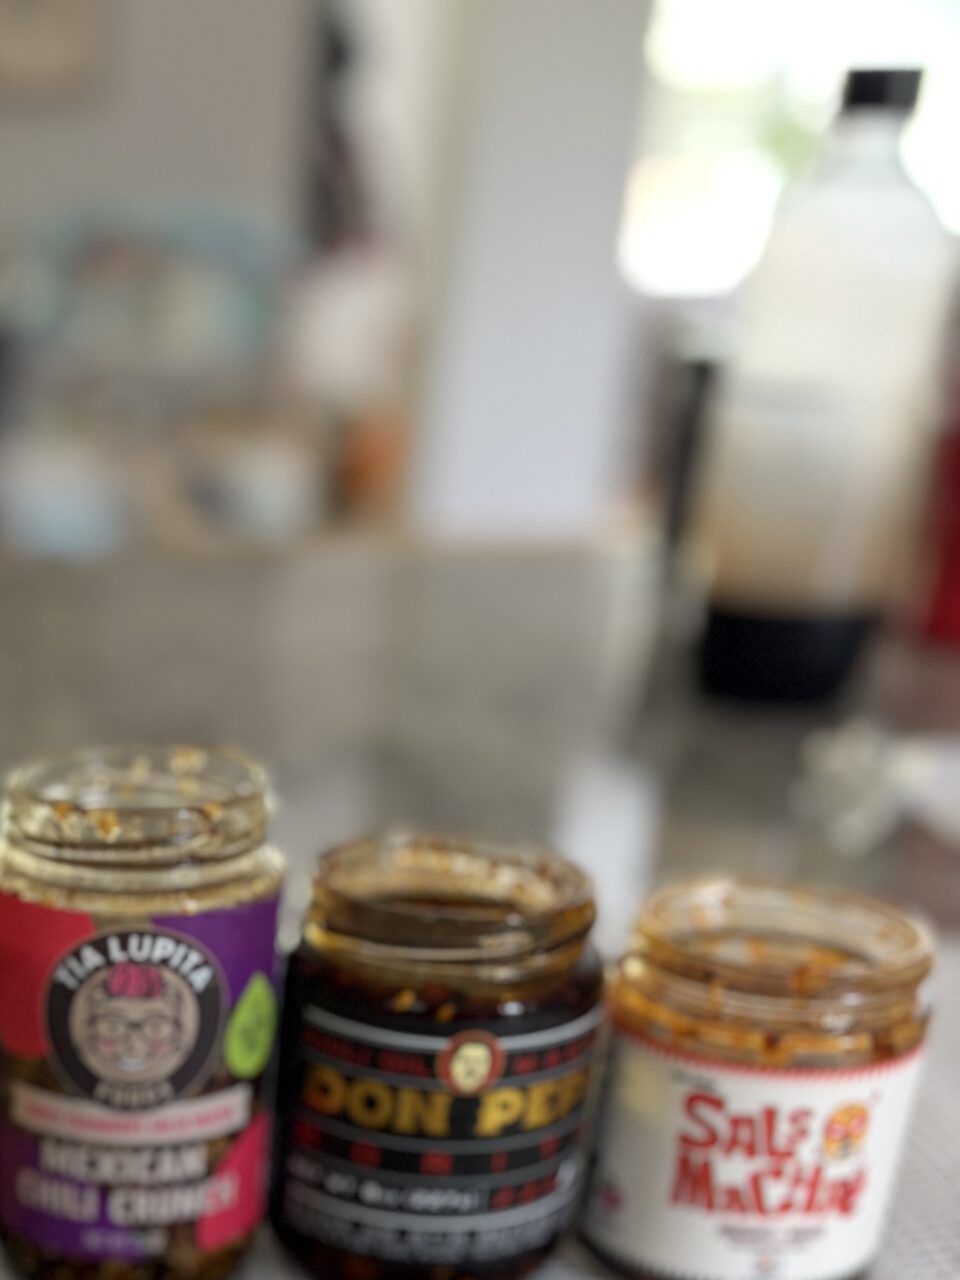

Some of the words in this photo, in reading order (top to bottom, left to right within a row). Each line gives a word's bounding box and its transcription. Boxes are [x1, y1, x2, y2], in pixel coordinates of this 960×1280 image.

[54, 943, 106, 990] TIA
[107, 933, 214, 993] LUPITA
[303, 1062, 452, 1136] DON
